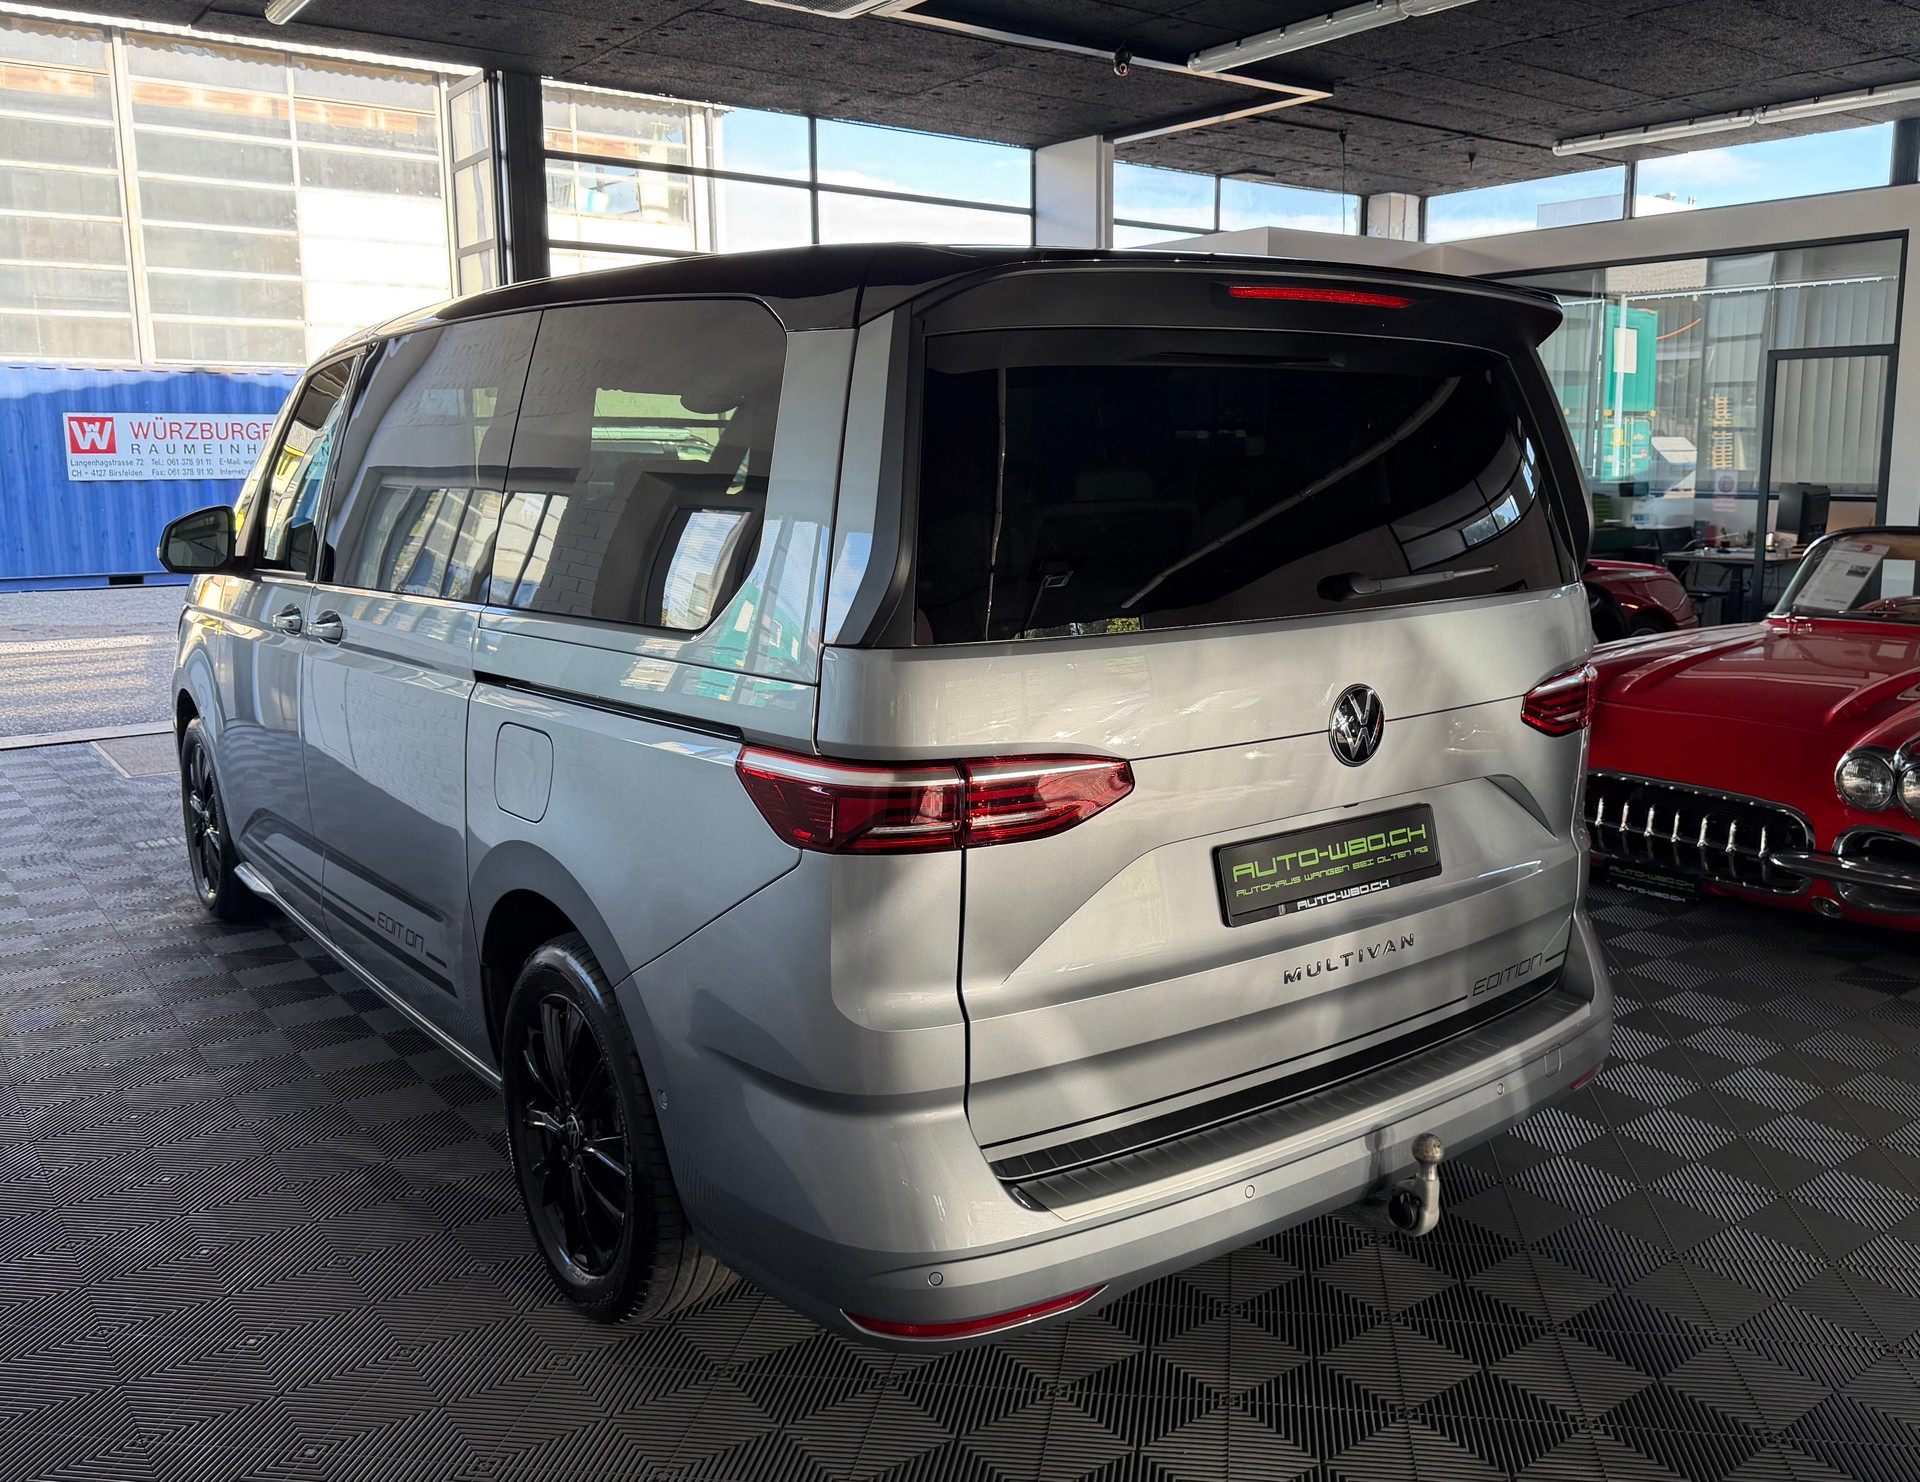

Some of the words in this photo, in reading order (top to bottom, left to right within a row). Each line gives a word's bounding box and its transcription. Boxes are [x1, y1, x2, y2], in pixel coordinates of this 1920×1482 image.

[70, 459, 134, 468] Langenhagstrasse
[166, 458, 179, 466] 061
[181, 458, 194, 466] 378
[196, 458, 204, 466] 91
[205, 458, 212, 466] 11
[131, 443, 257, 455] RAUMEINH
[71, 469, 82, 477] CH
[91, 469, 107, 477] 4127
[109, 469, 143, 477] Birsfelden
[167, 468, 180, 477] 061
[182, 468, 194, 476] 378
[196, 468, 204, 476] 91
[206, 468, 214, 476] 10
[1232, 823, 1427, 882] AUTO-WBO.CH
[1236, 876, 1302, 897] AUTOHAUS
[1304, 864, 1350, 881] WANGEN
[1352, 857, 1375, 870] BEI
[1377, 849, 1412, 865] OLTEN
[1414, 845, 1429, 855] AG
[1296, 879, 1390, 911] AUTO-WBO.CH
[377, 911, 425, 954] EDITON
[1283, 933, 1415, 985] MULTIVAN
[1472, 952, 1544, 997] EDITION
